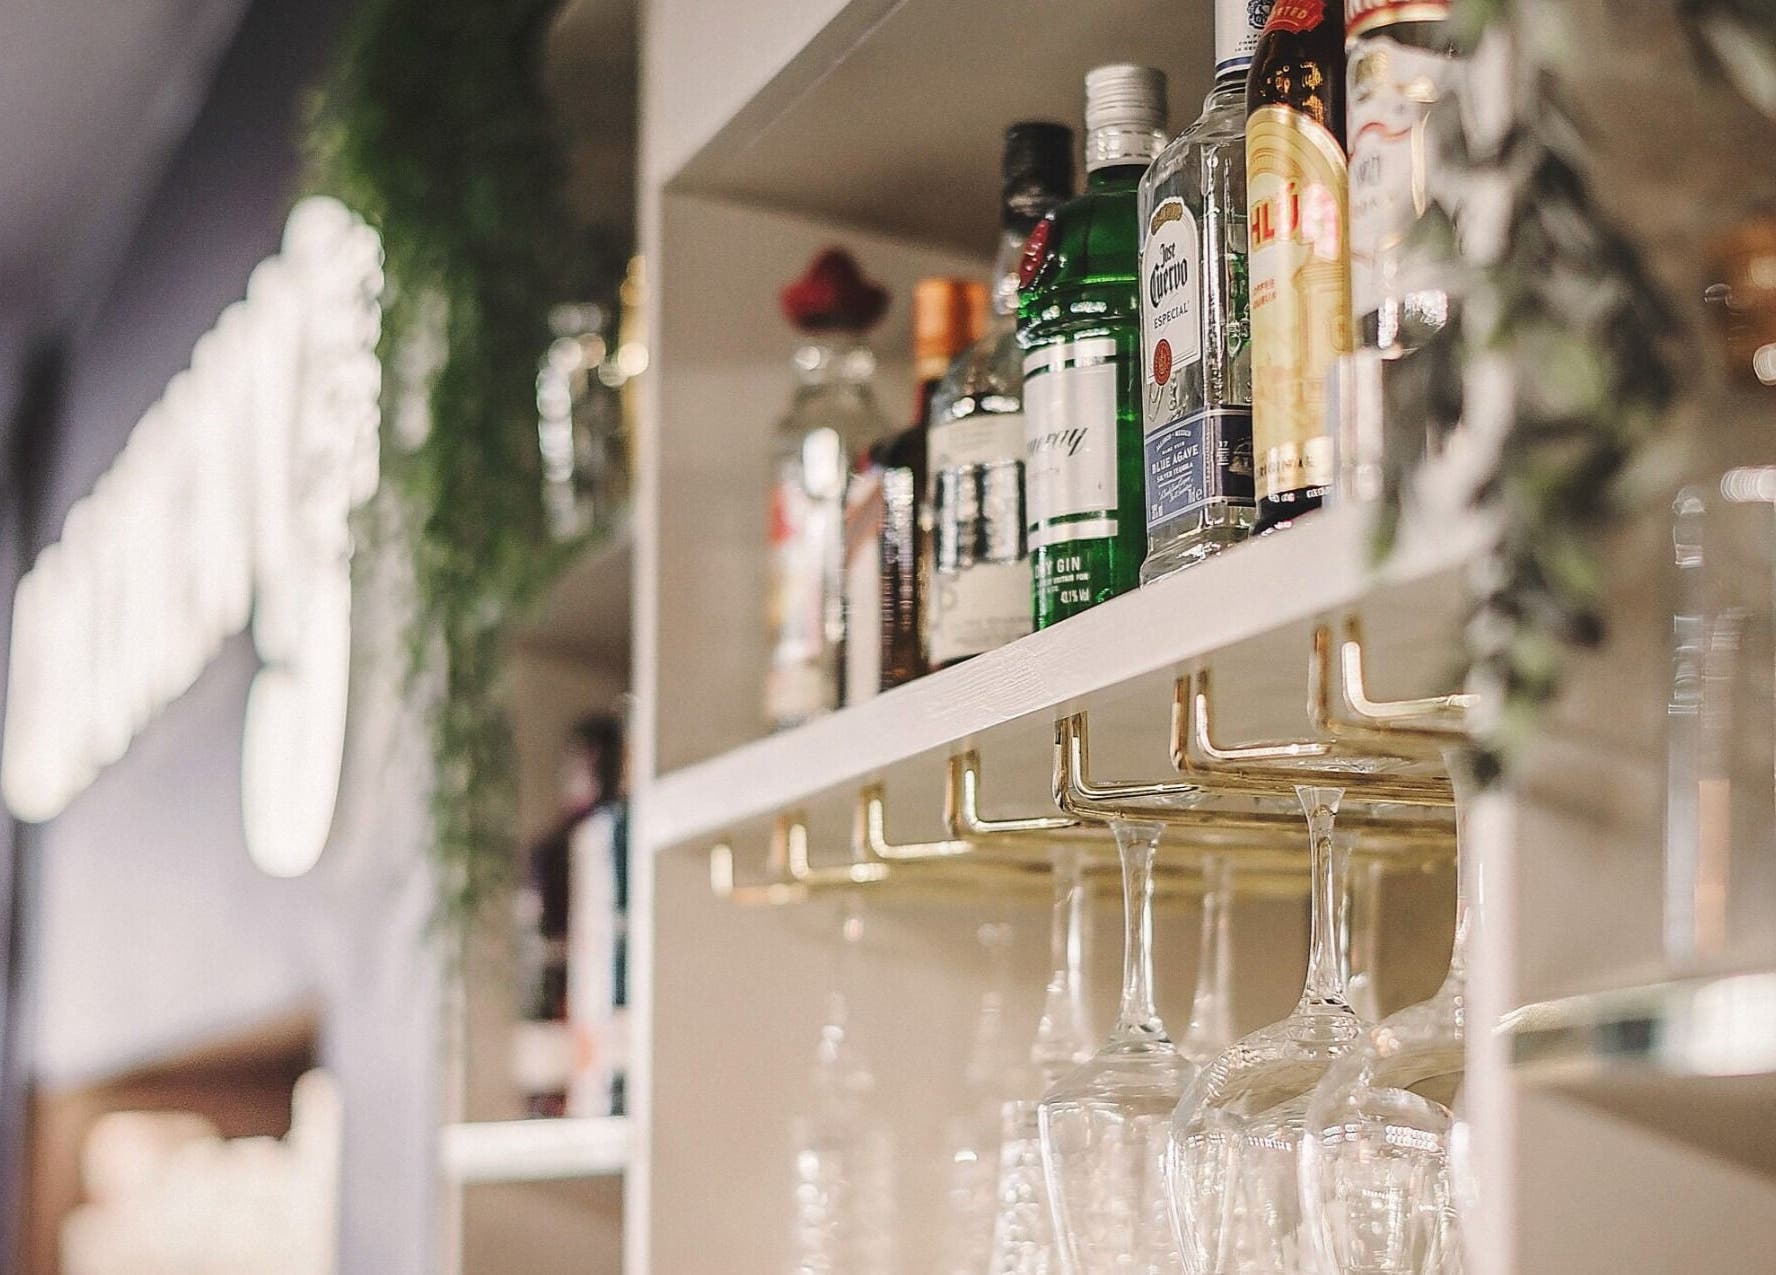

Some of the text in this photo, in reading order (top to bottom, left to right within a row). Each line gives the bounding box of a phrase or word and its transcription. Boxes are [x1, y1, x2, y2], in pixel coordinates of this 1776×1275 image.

[1160, 242, 1175, 268] Jose
[1149, 258, 1188, 309] Cuervo
[1153, 302, 1189, 329] ESPECIAL
[1151, 457, 1171, 475] BLUE
[1172, 444, 1199, 467] AGAVE
[1056, 556, 1081, 574] GIN
